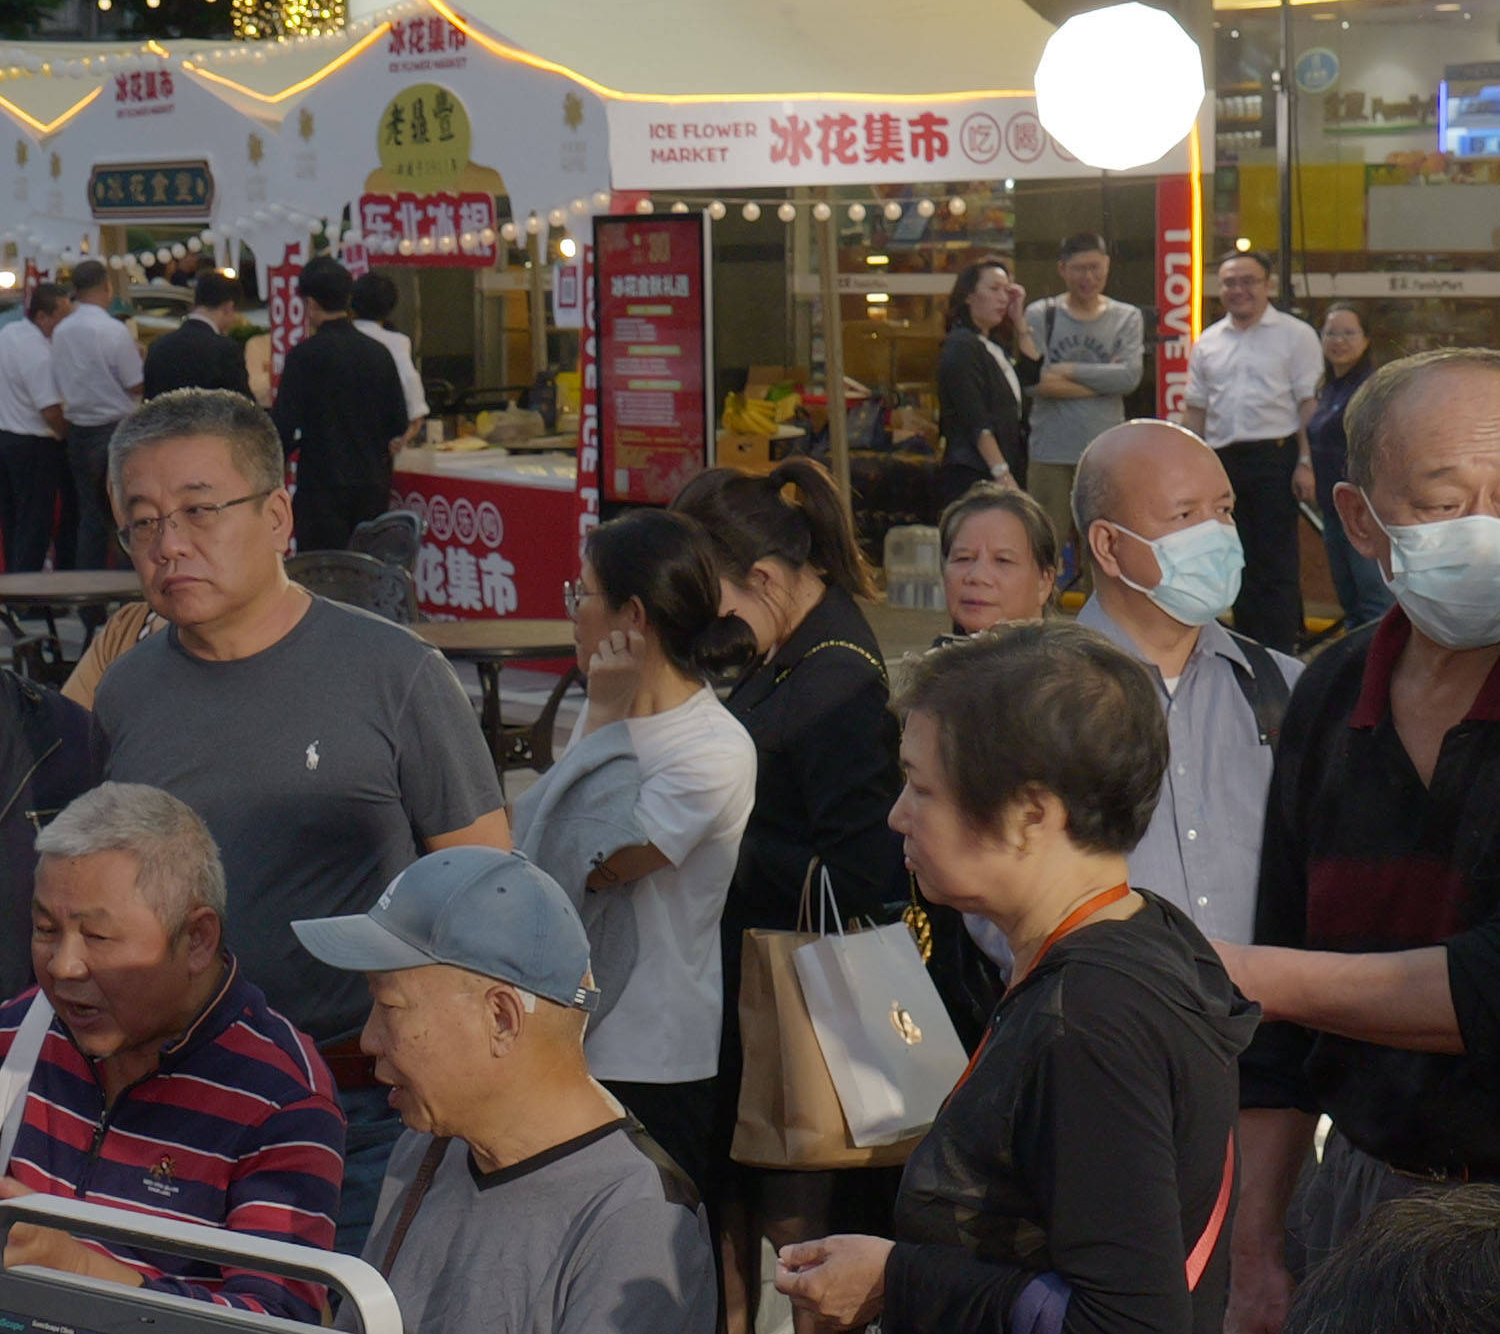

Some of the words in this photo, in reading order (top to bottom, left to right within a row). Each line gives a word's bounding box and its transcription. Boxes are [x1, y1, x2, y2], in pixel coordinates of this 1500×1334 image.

[649, 123, 679, 140] ICE
[682, 121, 758, 140] FLOWER
[769, 111, 950, 166] 冰花集市
[650, 146, 729, 164] MARKET
[1164, 252, 1192, 360] LOVE
